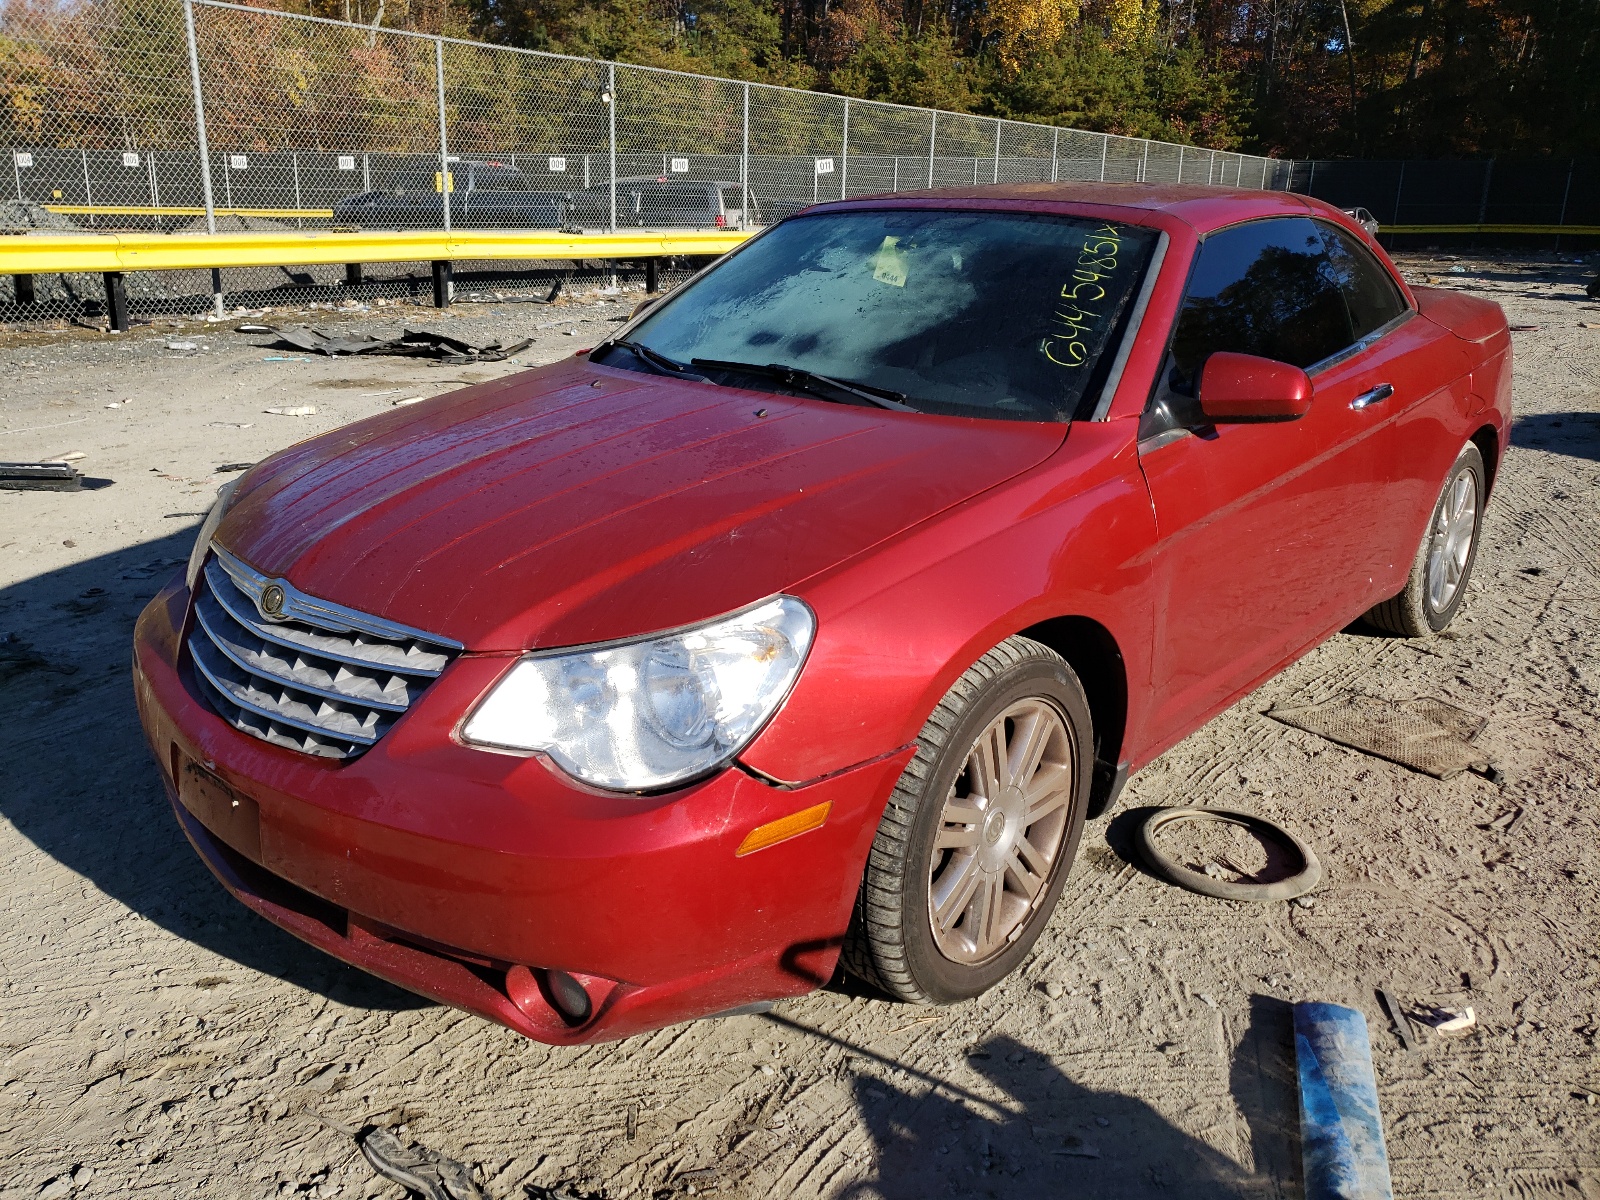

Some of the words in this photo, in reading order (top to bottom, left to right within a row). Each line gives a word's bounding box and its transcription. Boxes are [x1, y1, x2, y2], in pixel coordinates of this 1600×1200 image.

[551, 159, 564, 169] 009
[674, 160, 686, 170] 010
[819, 161, 831, 171] 011
